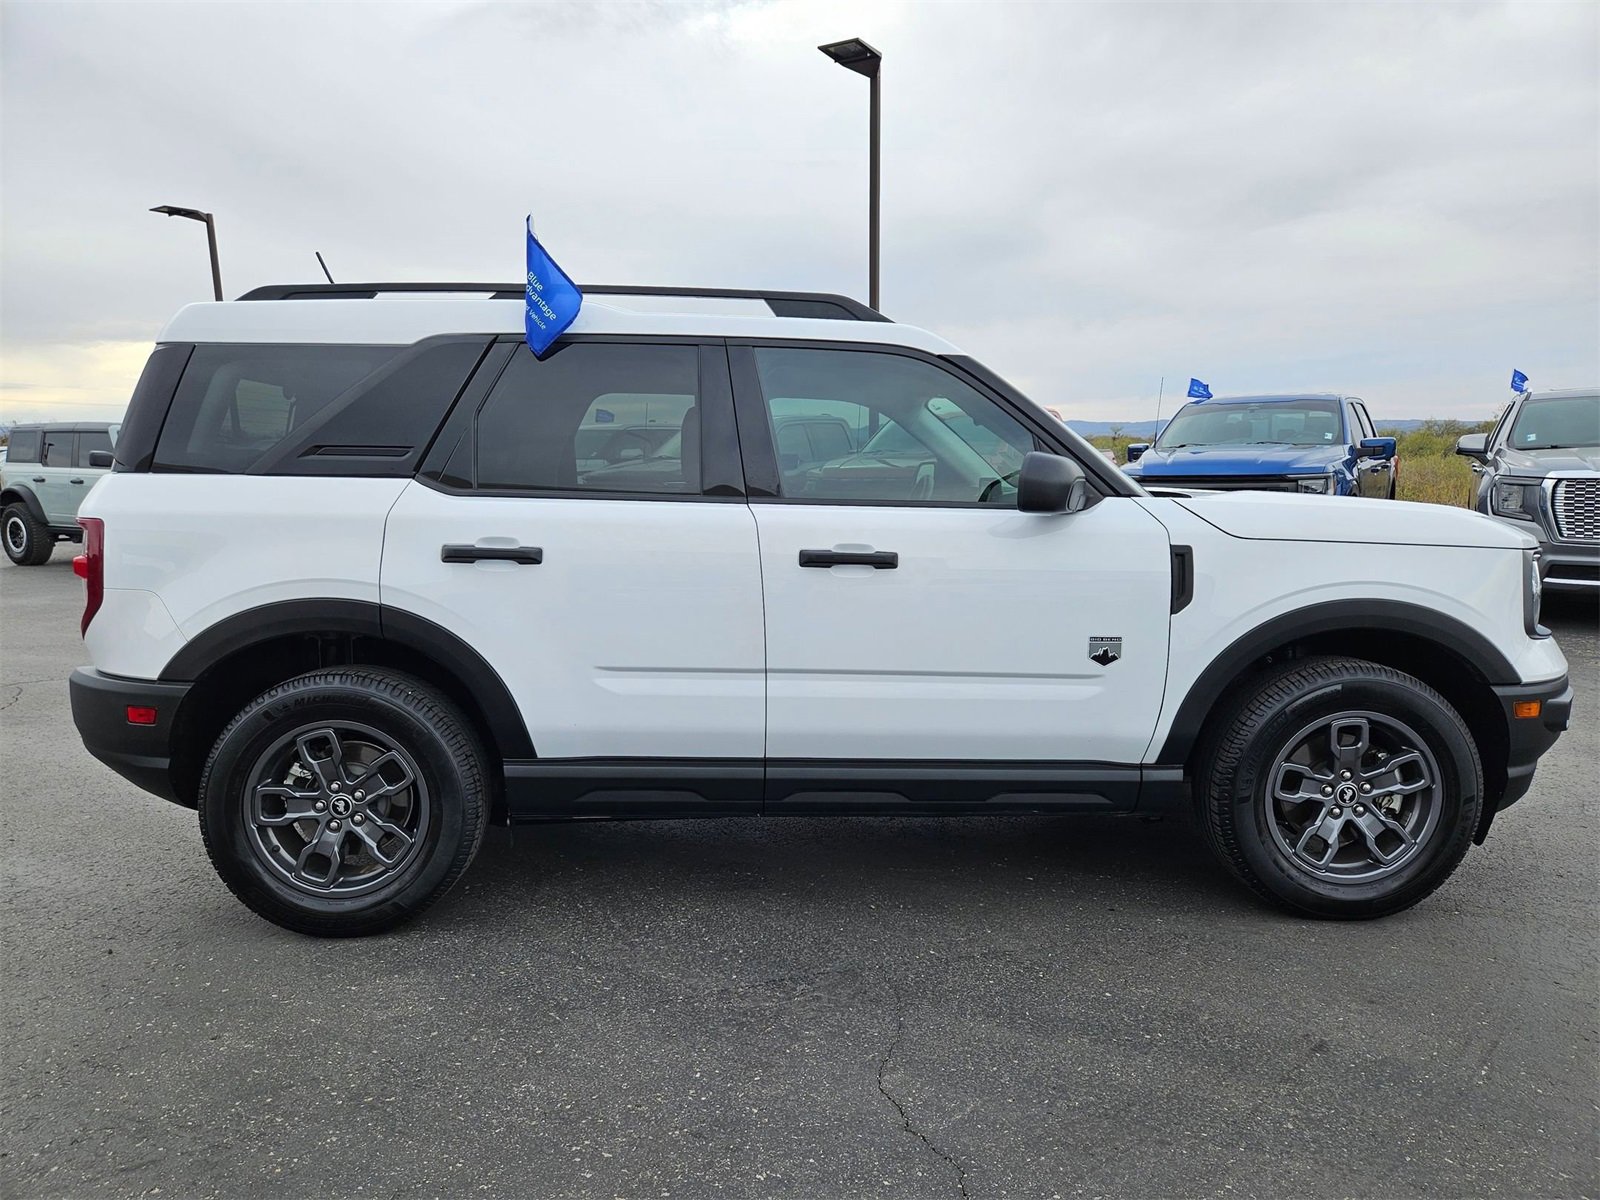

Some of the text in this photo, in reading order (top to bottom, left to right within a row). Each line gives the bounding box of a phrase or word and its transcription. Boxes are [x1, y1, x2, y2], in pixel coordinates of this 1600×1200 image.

[528, 271, 543, 292] Blue
[526, 284, 557, 320] dvantage
[529, 309, 546, 330] Vehicle
